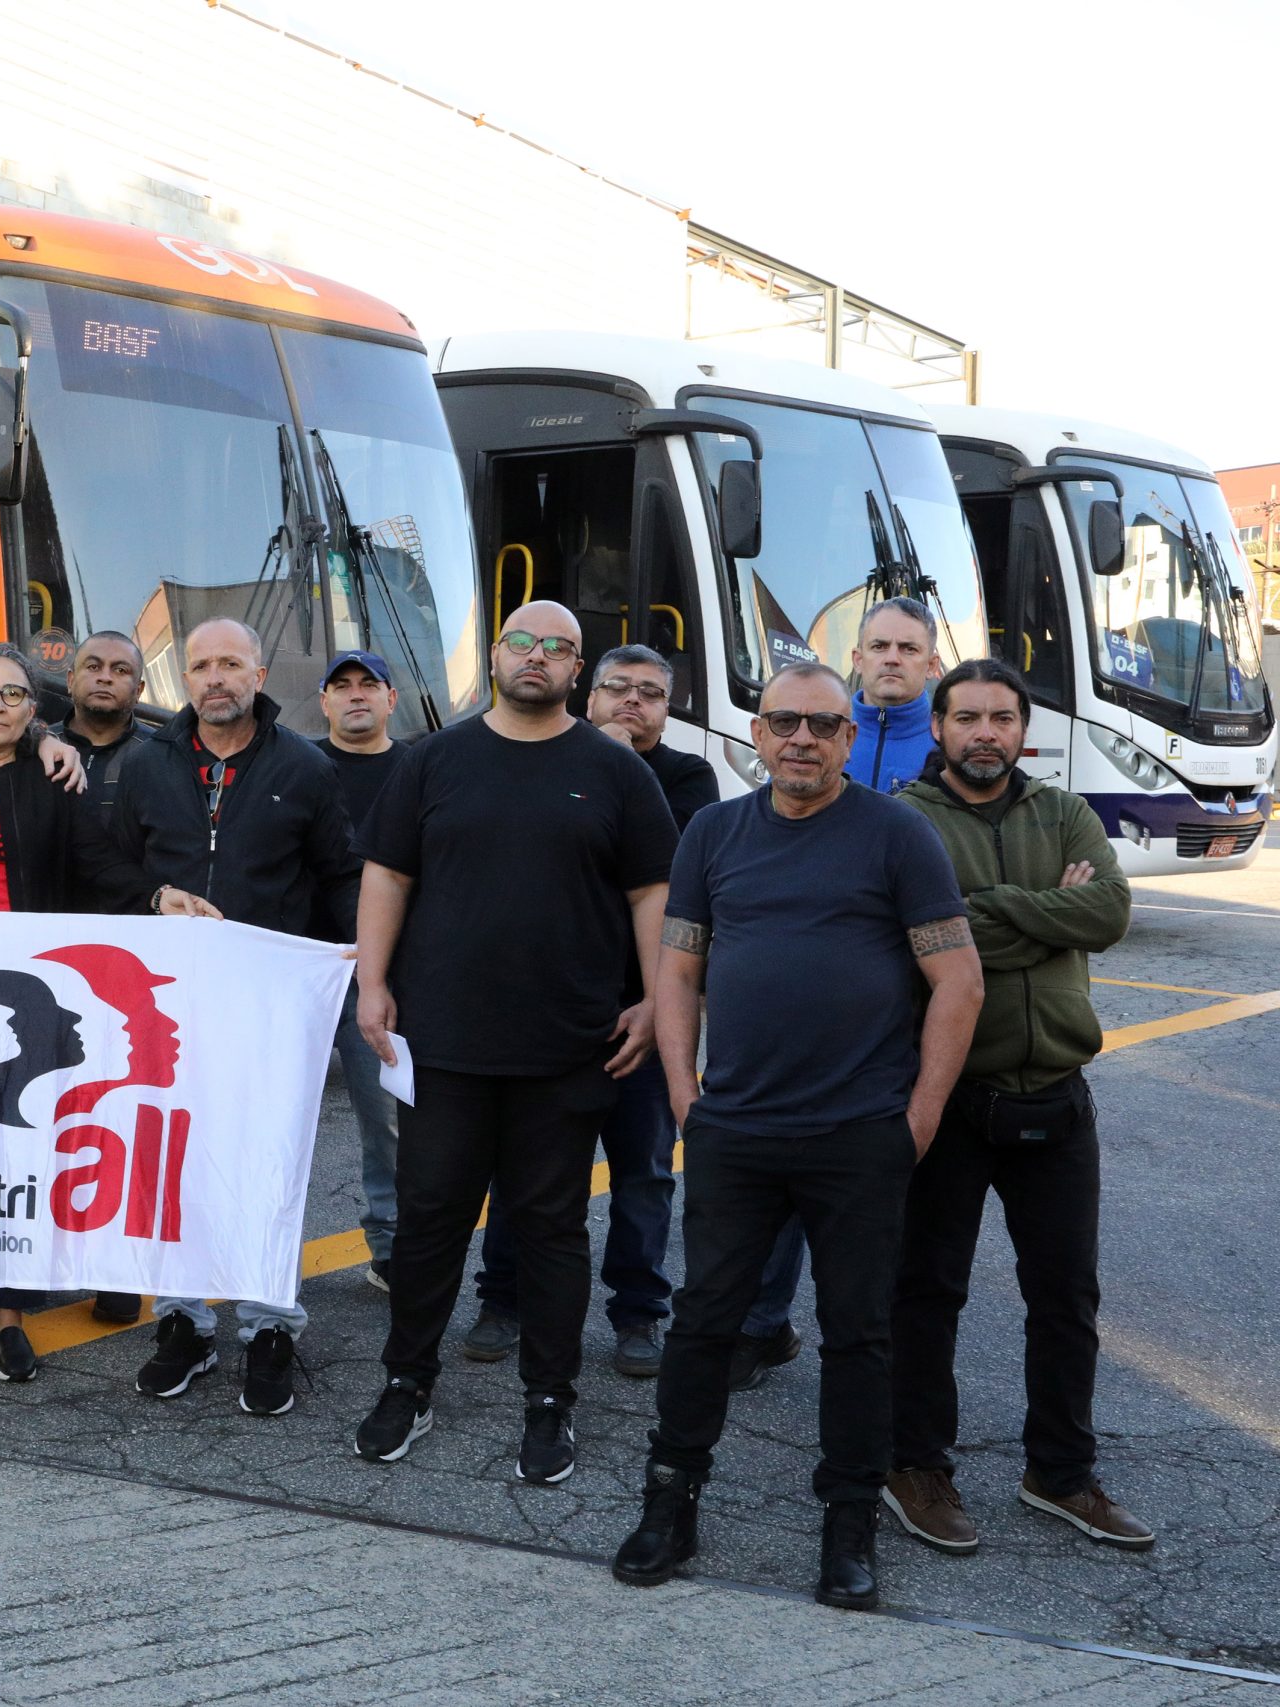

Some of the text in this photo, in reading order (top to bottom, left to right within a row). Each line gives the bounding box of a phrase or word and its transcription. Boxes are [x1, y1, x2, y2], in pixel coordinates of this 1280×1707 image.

[156, 236, 319, 297] GOL
[84, 321, 160, 357] BASF
[789, 643, 816, 662] BASF
[1114, 655, 1139, 677] 04
[1169, 738, 1178, 754] F
[49, 1103, 191, 1243] all
